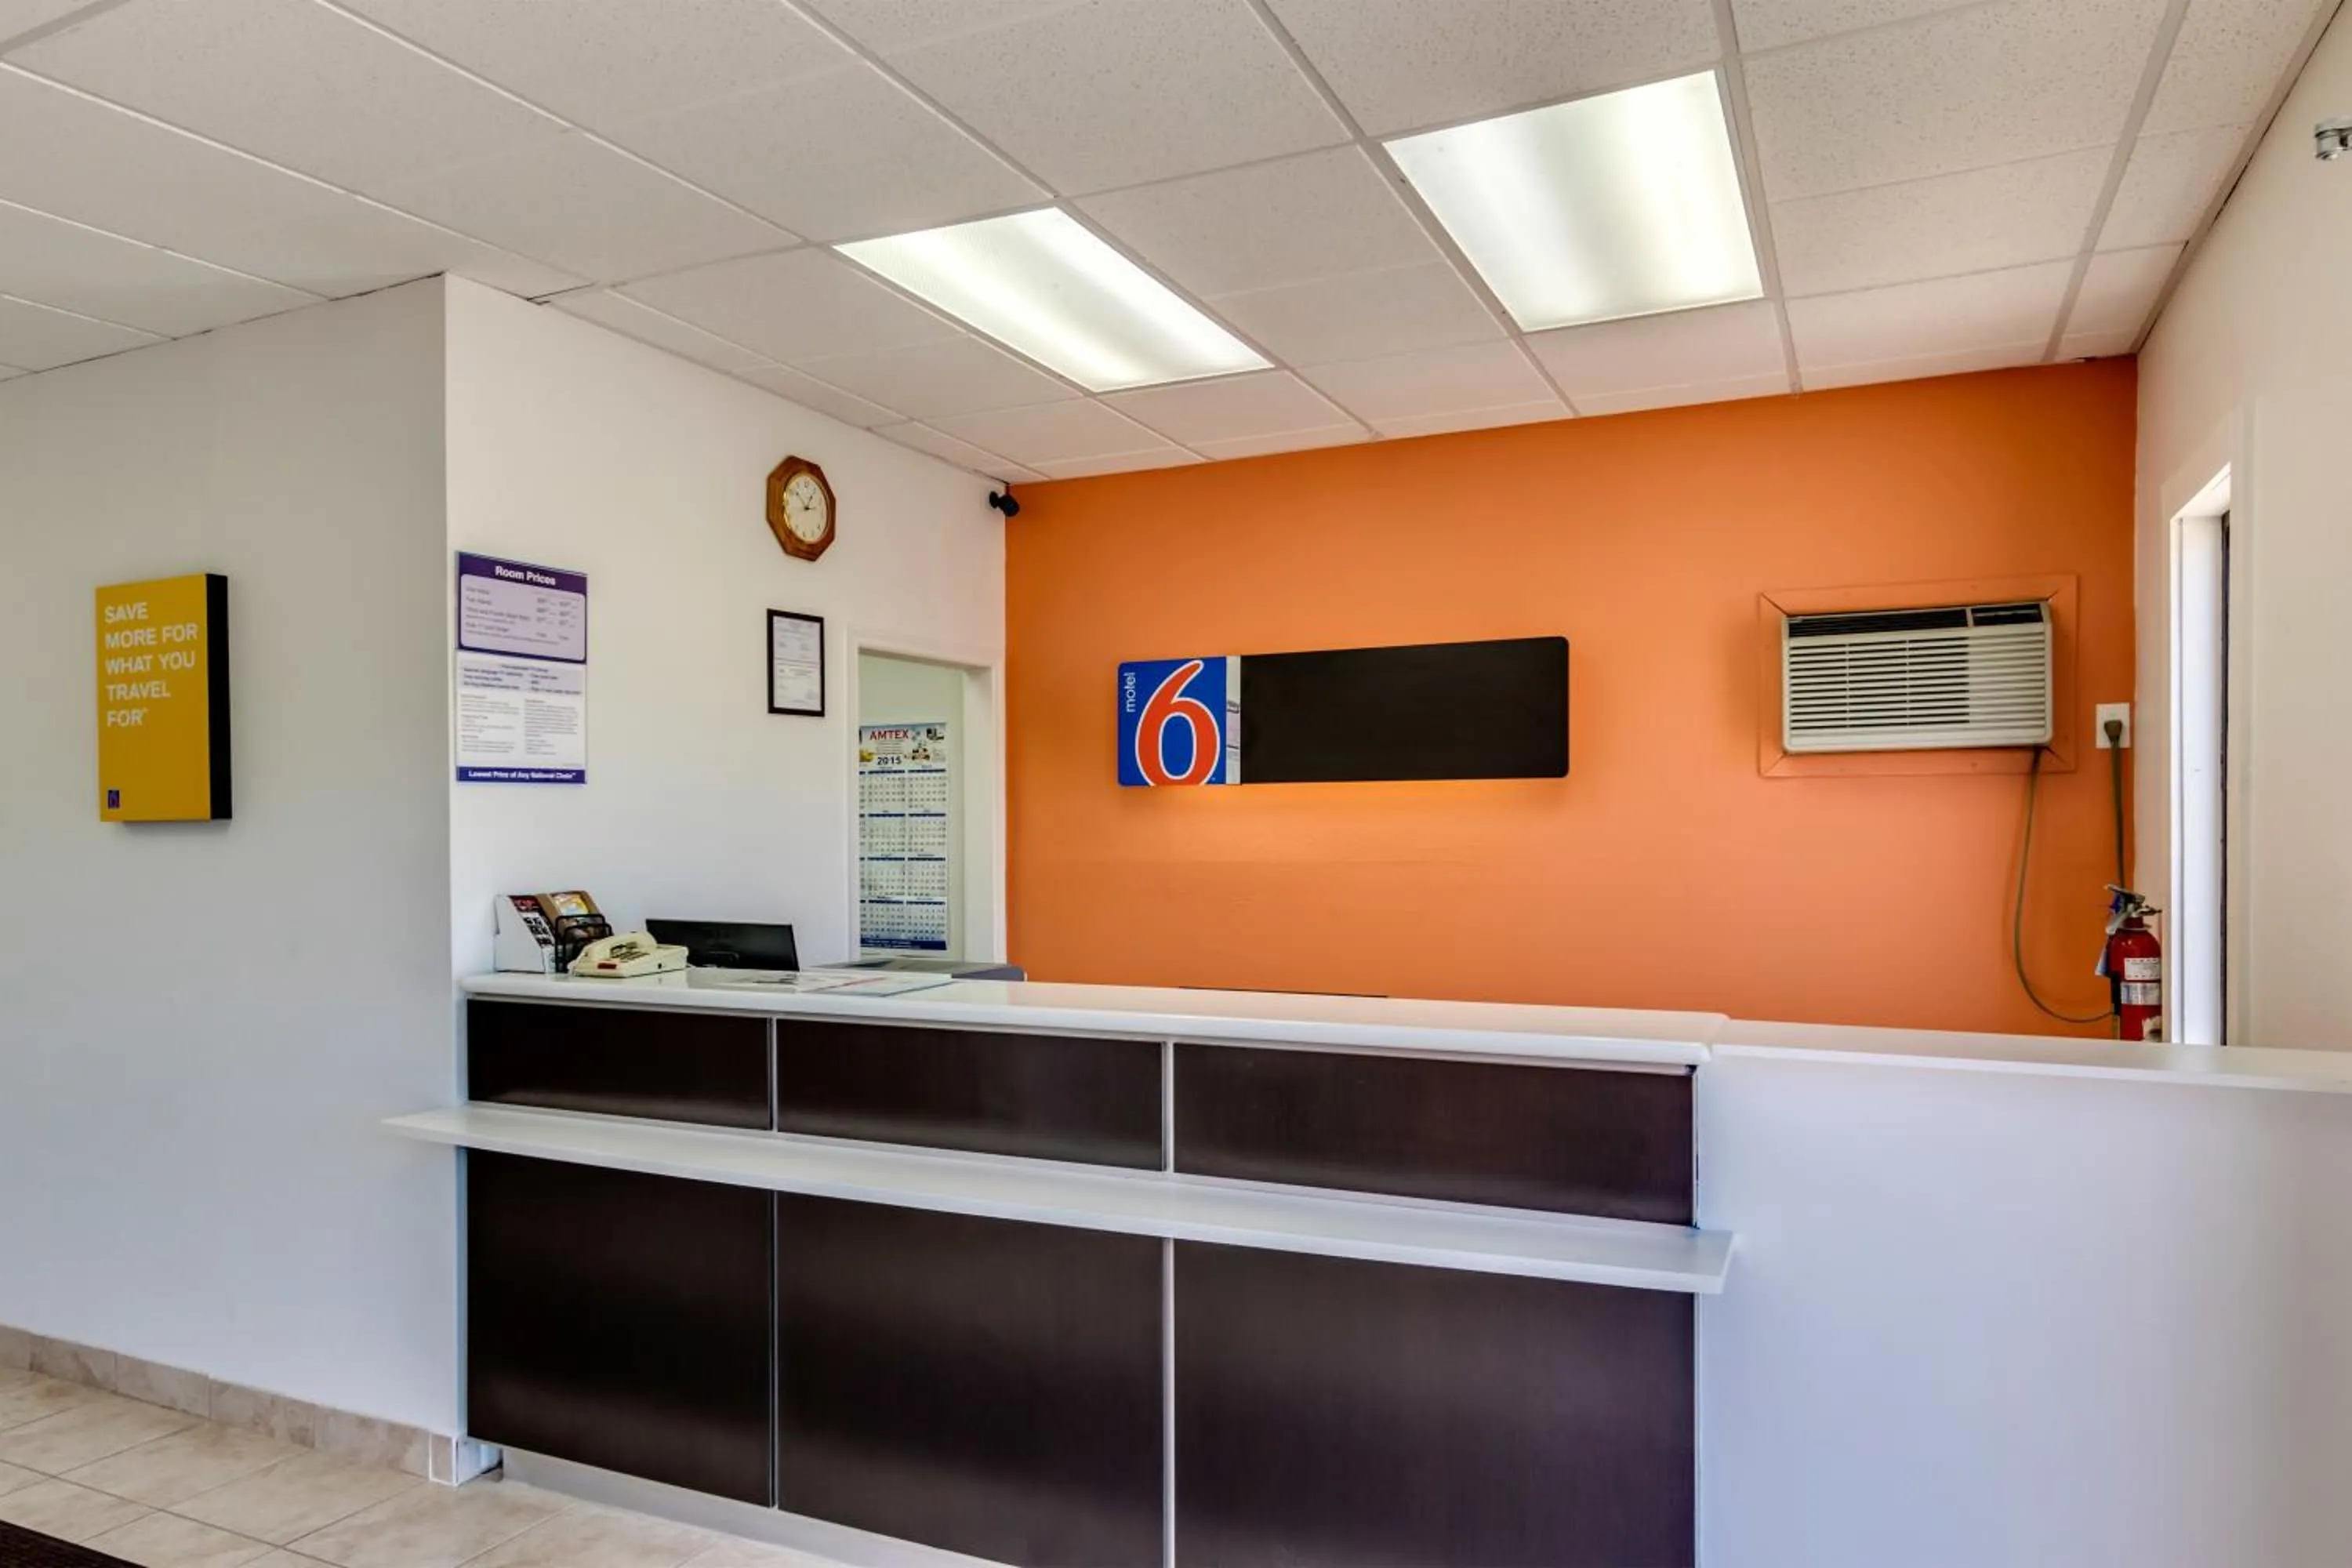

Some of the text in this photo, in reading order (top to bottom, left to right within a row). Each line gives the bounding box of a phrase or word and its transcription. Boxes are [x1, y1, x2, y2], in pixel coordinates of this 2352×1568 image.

[495, 565, 556, 586] Room Prices
[104, 602, 148, 623] SAVE
[105, 623, 198, 649] MORE FOR
[105, 652, 195, 675] WHAT YOU
[106, 681, 171, 702] TRAVEL
[1123, 659, 1221, 786] motel 6
[870, 729, 909, 741] AMTEX
[877, 756, 902, 766] 2015
